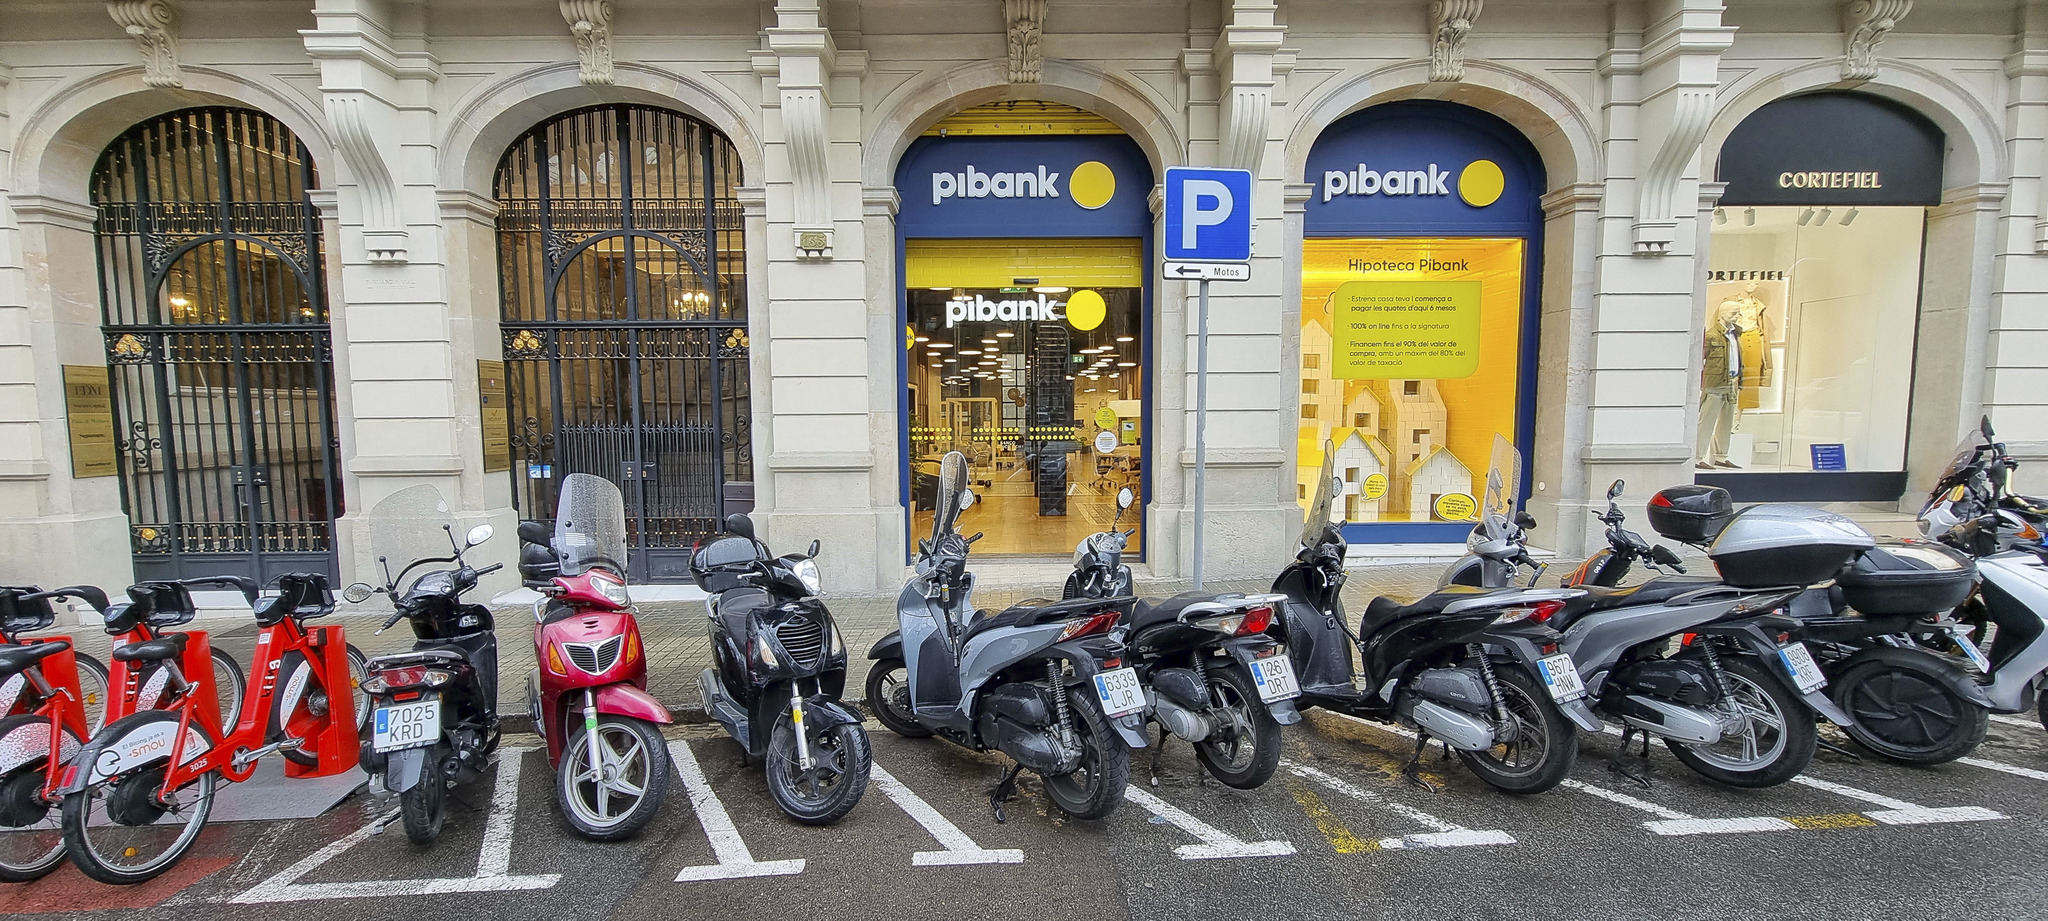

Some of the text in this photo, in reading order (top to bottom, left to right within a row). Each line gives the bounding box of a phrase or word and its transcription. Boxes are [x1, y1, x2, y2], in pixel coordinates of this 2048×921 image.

[932, 164, 1060, 205] pibank
[1323, 163, 1450, 203] pibank
[1779, 171, 1883, 189] CORTEFIEL
[1182, 179, 1234, 249] P
[1214, 267, 1240, 277] Motos
[1349, 258, 1469, 274] Hipoteca Pibank
[1415, 295, 1446, 303] comença
[945, 294, 1058, 328] pibank
[1418, 323, 1450, 331] signatura
[1439, 349, 1454, 357] 80%
[1546, 656, 1574, 676] 9672
[1786, 646, 1810, 666] 9908
[1260, 658, 1288, 678] 1261
[1796, 664, 1815, 684] KRF
[1104, 671, 1136, 691] 6339
[1267, 675, 1290, 695] DRT
[1109, 689, 1136, 709] LJR
[390, 704, 435, 725] 7025
[128, 737, 148, 748] Bicing
[389, 723, 423, 742] KRD
[131, 737, 166, 757] smou
[189, 757, 208, 773] 3025
